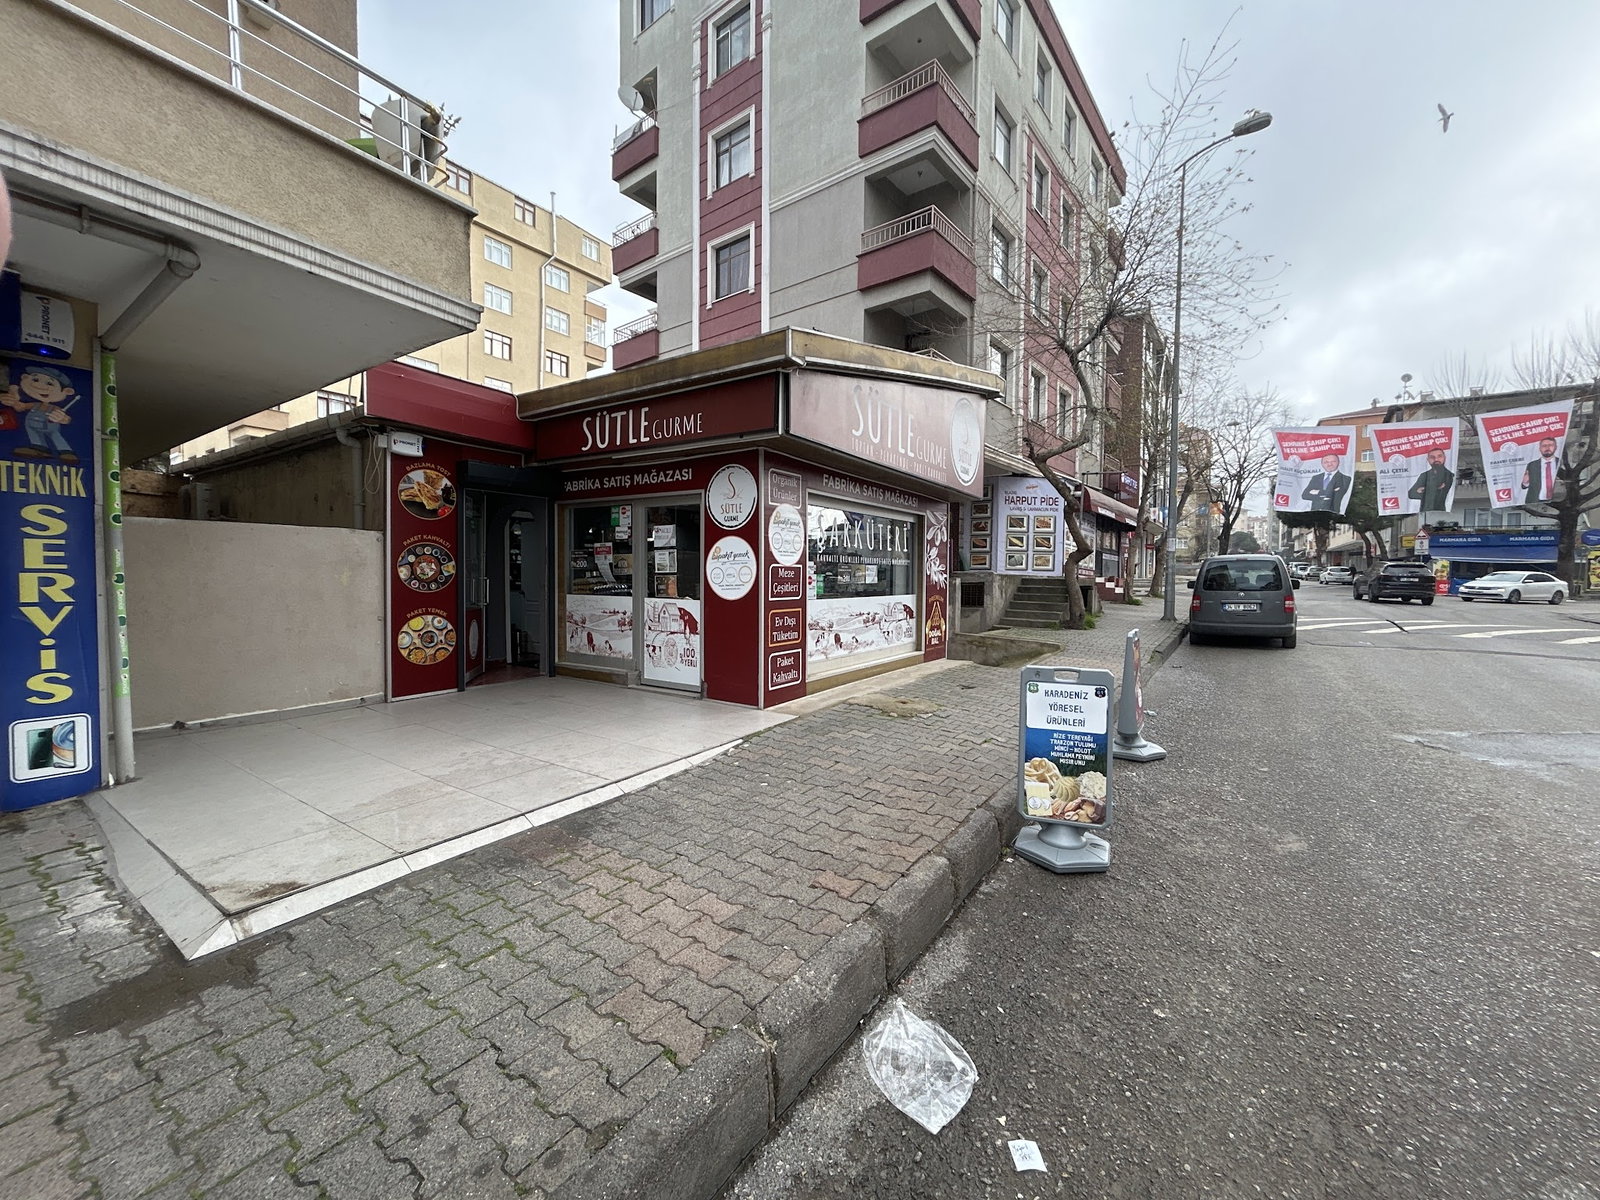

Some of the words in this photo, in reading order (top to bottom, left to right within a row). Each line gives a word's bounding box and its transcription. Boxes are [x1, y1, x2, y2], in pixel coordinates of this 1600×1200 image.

[581, 407, 650, 451] SÜTLE
[652, 413, 703, 440] GURME
[851, 385, 915, 457] SÜTLE
[916, 436, 947, 470] GURME
[406, 462, 435, 471] BAZLAMA
[436, 465, 451, 477] TOST
[603, 475, 631, 489] SATIŞ
[634, 468, 693, 485] MAĞAZASI
[772, 473, 798, 488] Organik
[823, 474, 861, 494] FABRİKA
[862, 484, 884, 501] SATIŞ
[885, 490, 918, 507] MAĞAZASI
[1004, 496, 1038, 506] HARPUT
[720, 503, 743, 514] SÜTLE
[724, 515, 739, 523] GURME
[403, 535, 421, 546] PAKET
[423, 534, 451, 549] KAHVALTI
[778, 568, 795, 578] Meze
[773, 582, 799, 594] Çeşitleri
[406, 608, 426, 618] PAKET
[427, 607, 448, 617] YEMEK
[775, 617, 783, 627] Ev
[772, 631, 799, 642] Tüketim
[777, 656, 794, 668] Paket
[773, 670, 798, 683] Kahvaltı
[1044, 689, 1089, 700] KARADENİZ
[1048, 702, 1084, 713] YÖRESEL
[1046, 715, 1086, 727] ÜRÜNLERİ
[1067, 734, 1093, 742] TEREYAĞI
[1074, 740, 1097, 748] TULUMU
